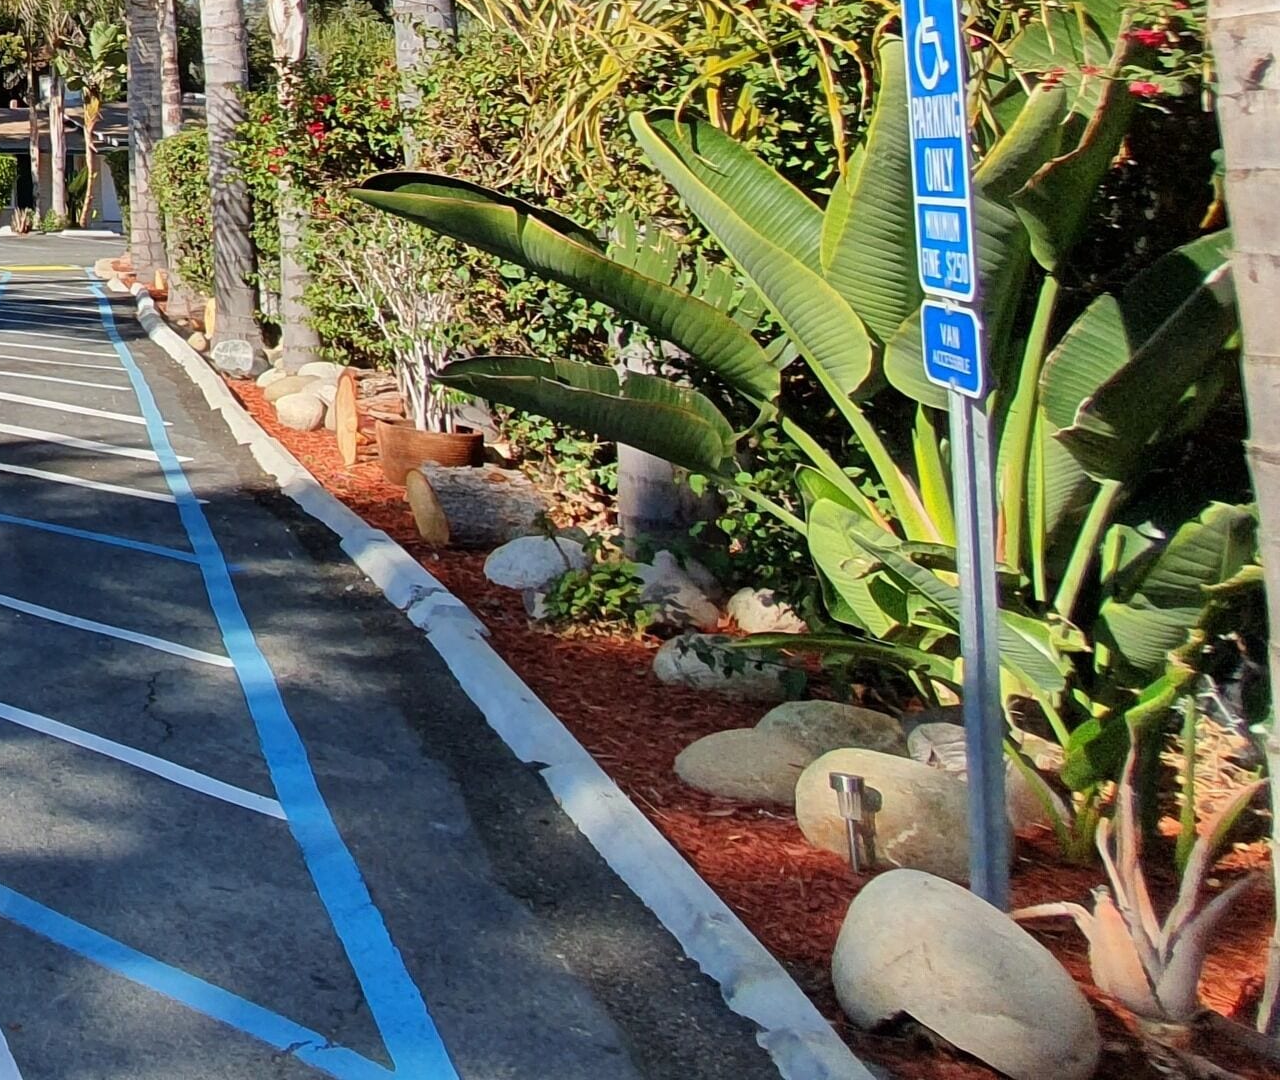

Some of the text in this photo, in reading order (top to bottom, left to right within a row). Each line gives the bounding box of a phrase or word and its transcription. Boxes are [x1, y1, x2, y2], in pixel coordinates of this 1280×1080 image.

[912, 92, 960, 139] PARKING
[924, 146, 954, 192] ONLY
[921, 247, 969, 284] FINE $250
[939, 322, 960, 350] VAN
